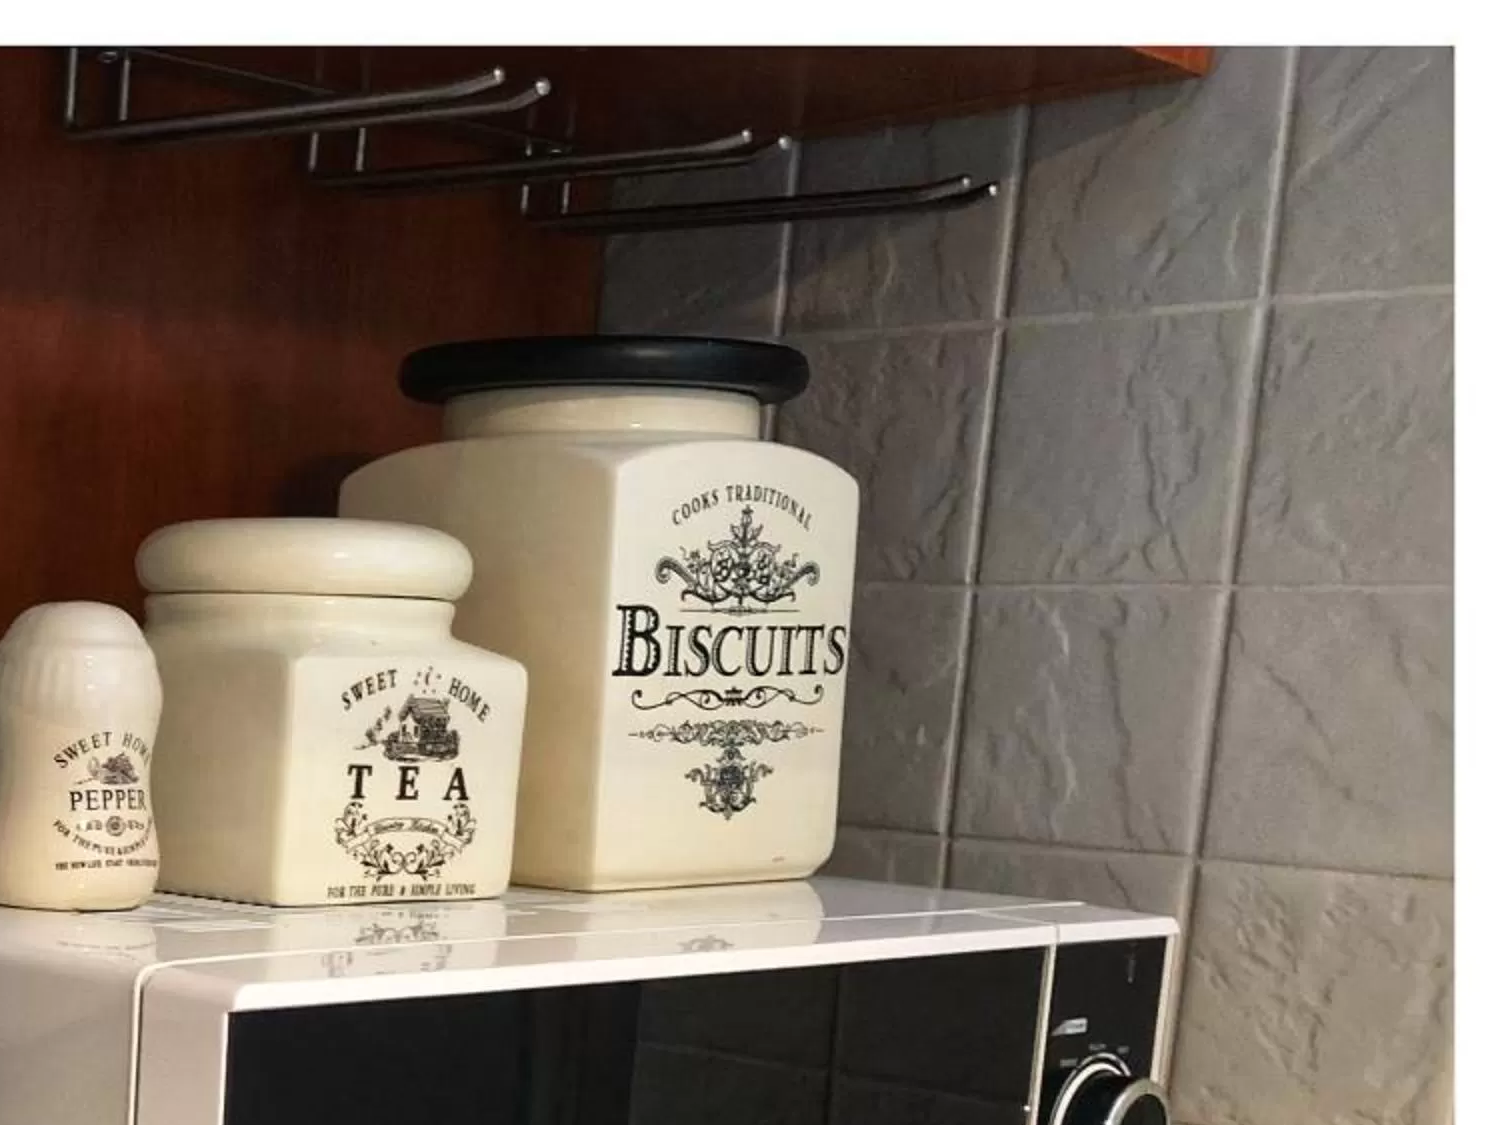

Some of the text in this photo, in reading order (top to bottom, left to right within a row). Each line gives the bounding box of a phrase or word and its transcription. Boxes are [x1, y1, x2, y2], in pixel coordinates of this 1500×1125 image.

[671, 484, 812, 532] COOKS TRADITIONAL
[611, 603, 847, 678] BISCUITS
[341, 669, 491, 723] SWEET HOME
[53, 731, 112, 769] SWEET
[68, 788, 147, 811] PEPPER
[347, 764, 470, 801] TEA
